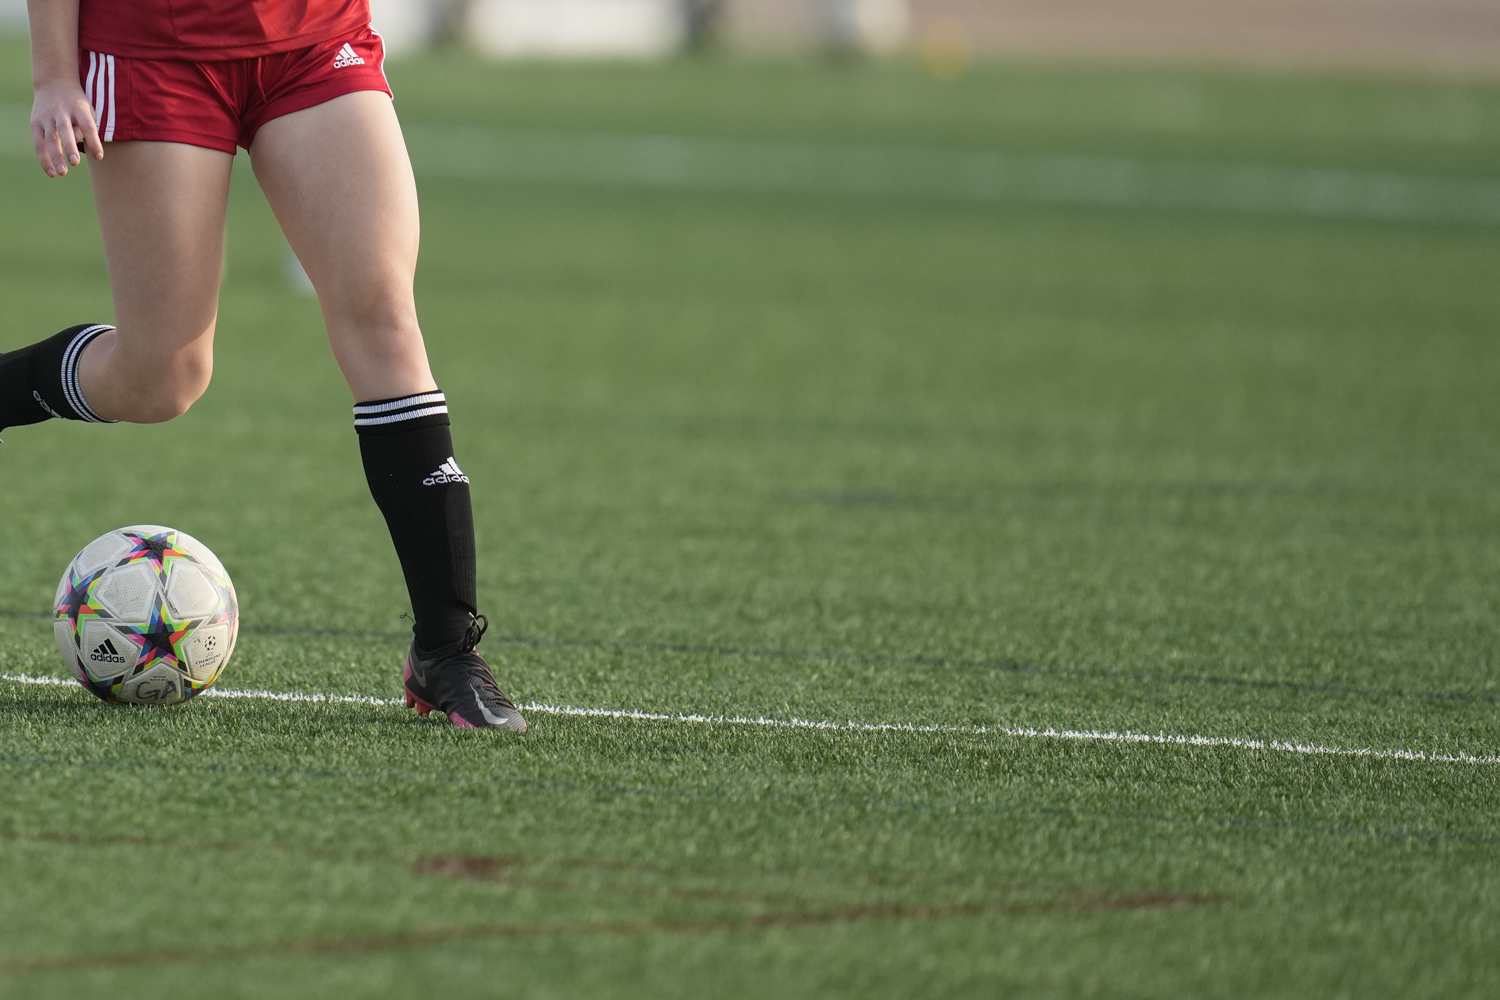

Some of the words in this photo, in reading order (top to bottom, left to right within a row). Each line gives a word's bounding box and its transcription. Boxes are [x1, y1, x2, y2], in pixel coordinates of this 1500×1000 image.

[333, 56, 365, 69] adidas
[422, 473, 470, 486] adida
[90, 652, 126, 664] adidas
